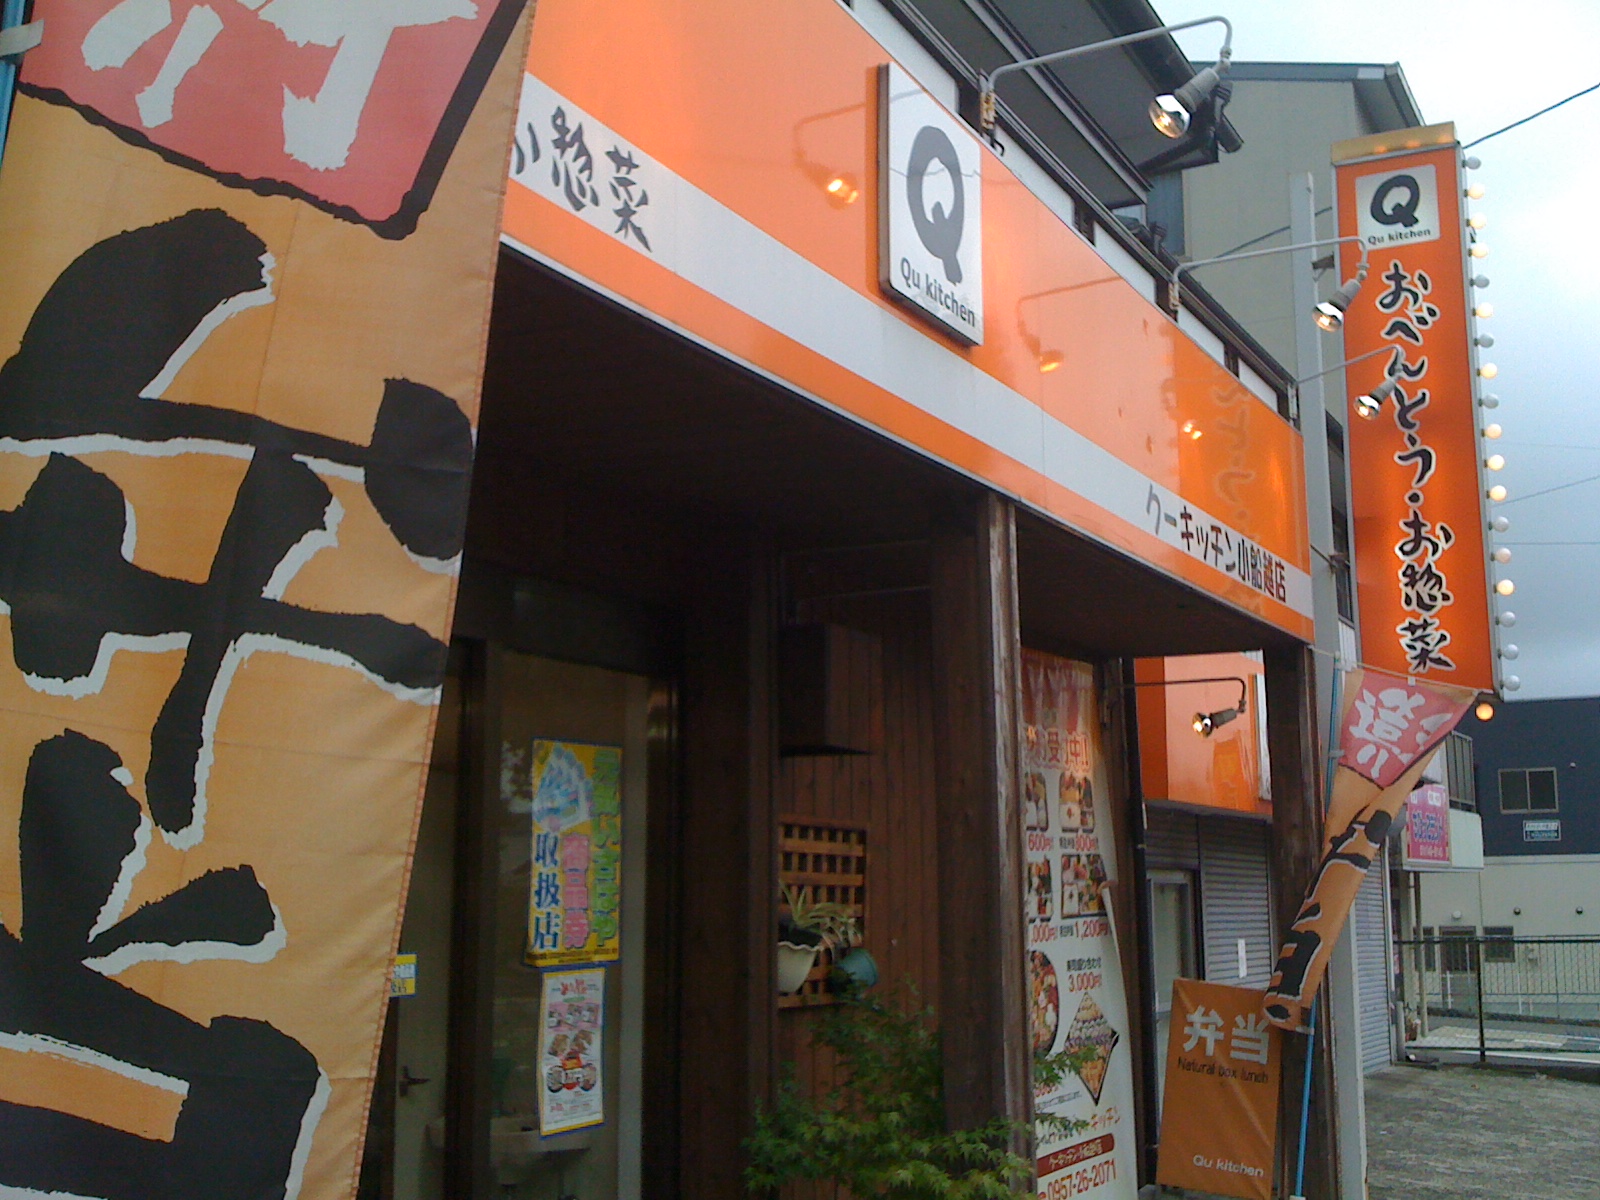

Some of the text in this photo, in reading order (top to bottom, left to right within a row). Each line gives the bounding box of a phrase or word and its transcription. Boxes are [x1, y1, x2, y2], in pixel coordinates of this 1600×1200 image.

[906, 124, 966, 286] Q
[1370, 174, 1421, 228] Q
[1367, 227, 1431, 246] Qu kitchen
[899, 255, 977, 329] Qu kitchen
[533, 831, 562, 951] 取扱店
[1183, 1004, 1270, 1065] 弁当
[1178, 1056, 1269, 1083] Natural box lunch
[1193, 1154, 1264, 1177] Qu kitchen
